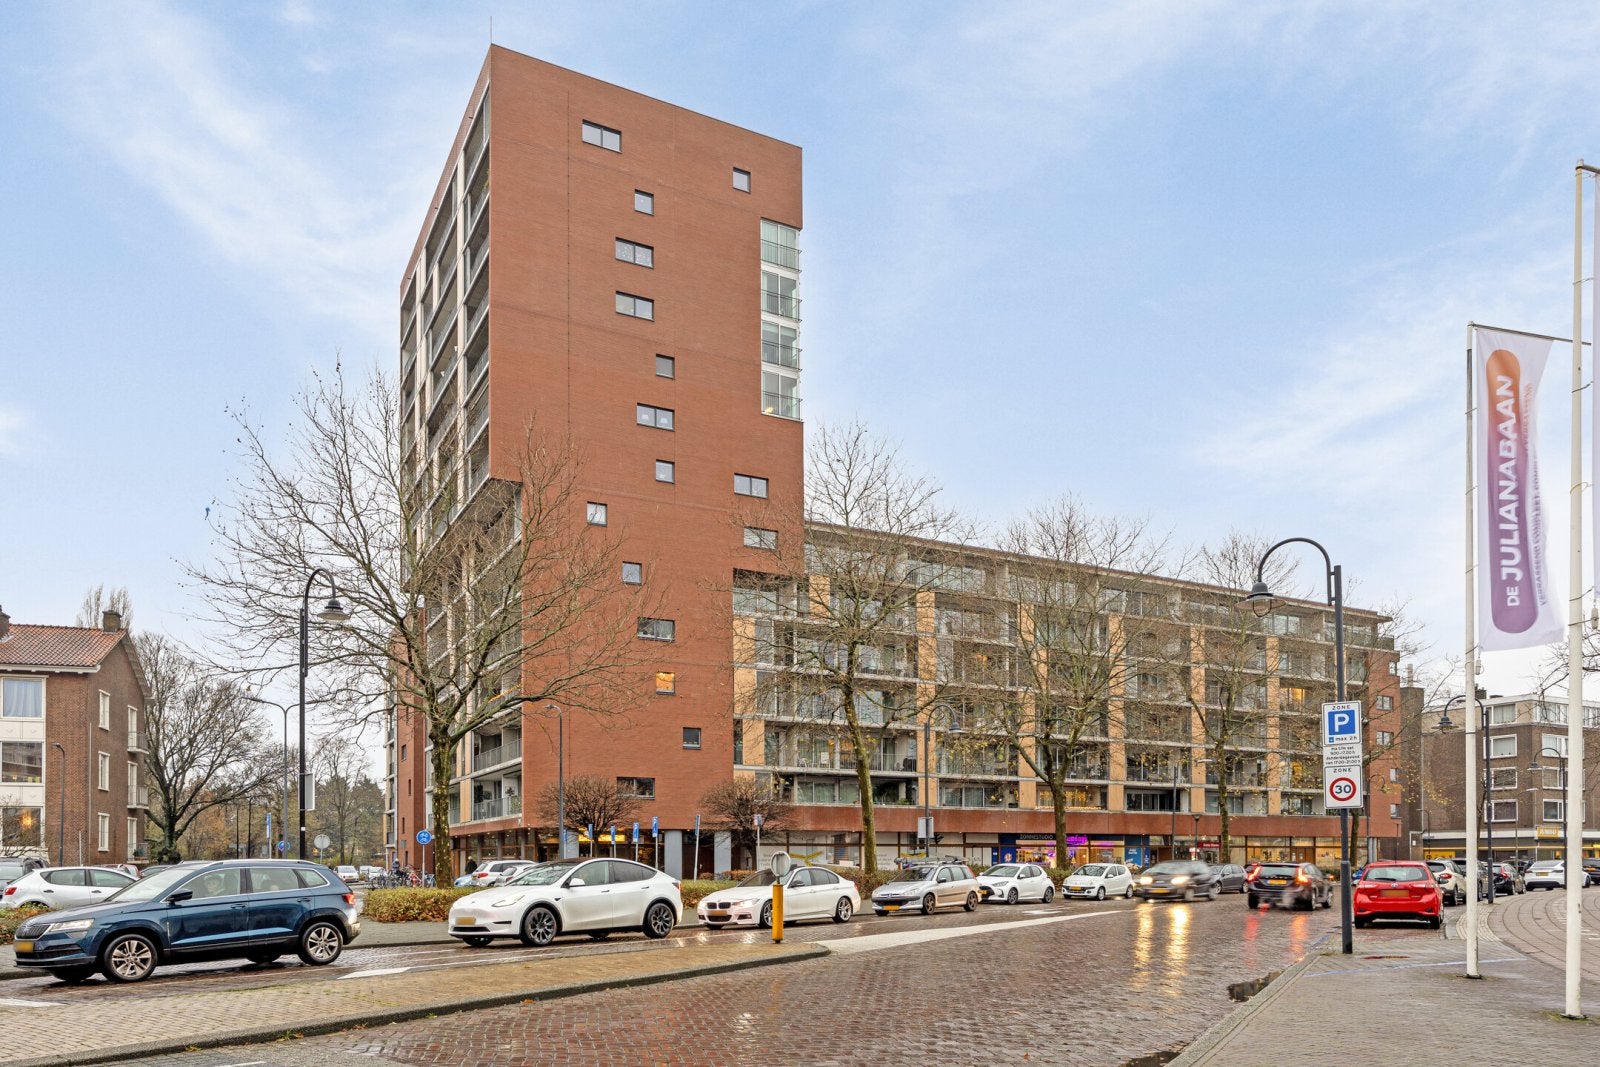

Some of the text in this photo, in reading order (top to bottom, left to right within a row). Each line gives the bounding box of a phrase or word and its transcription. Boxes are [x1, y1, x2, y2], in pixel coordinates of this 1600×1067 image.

[1496, 375, 1523, 606] DE JULIANABAAN
[1334, 713, 1350, 733] P
[1335, 784, 1352, 794] 30
